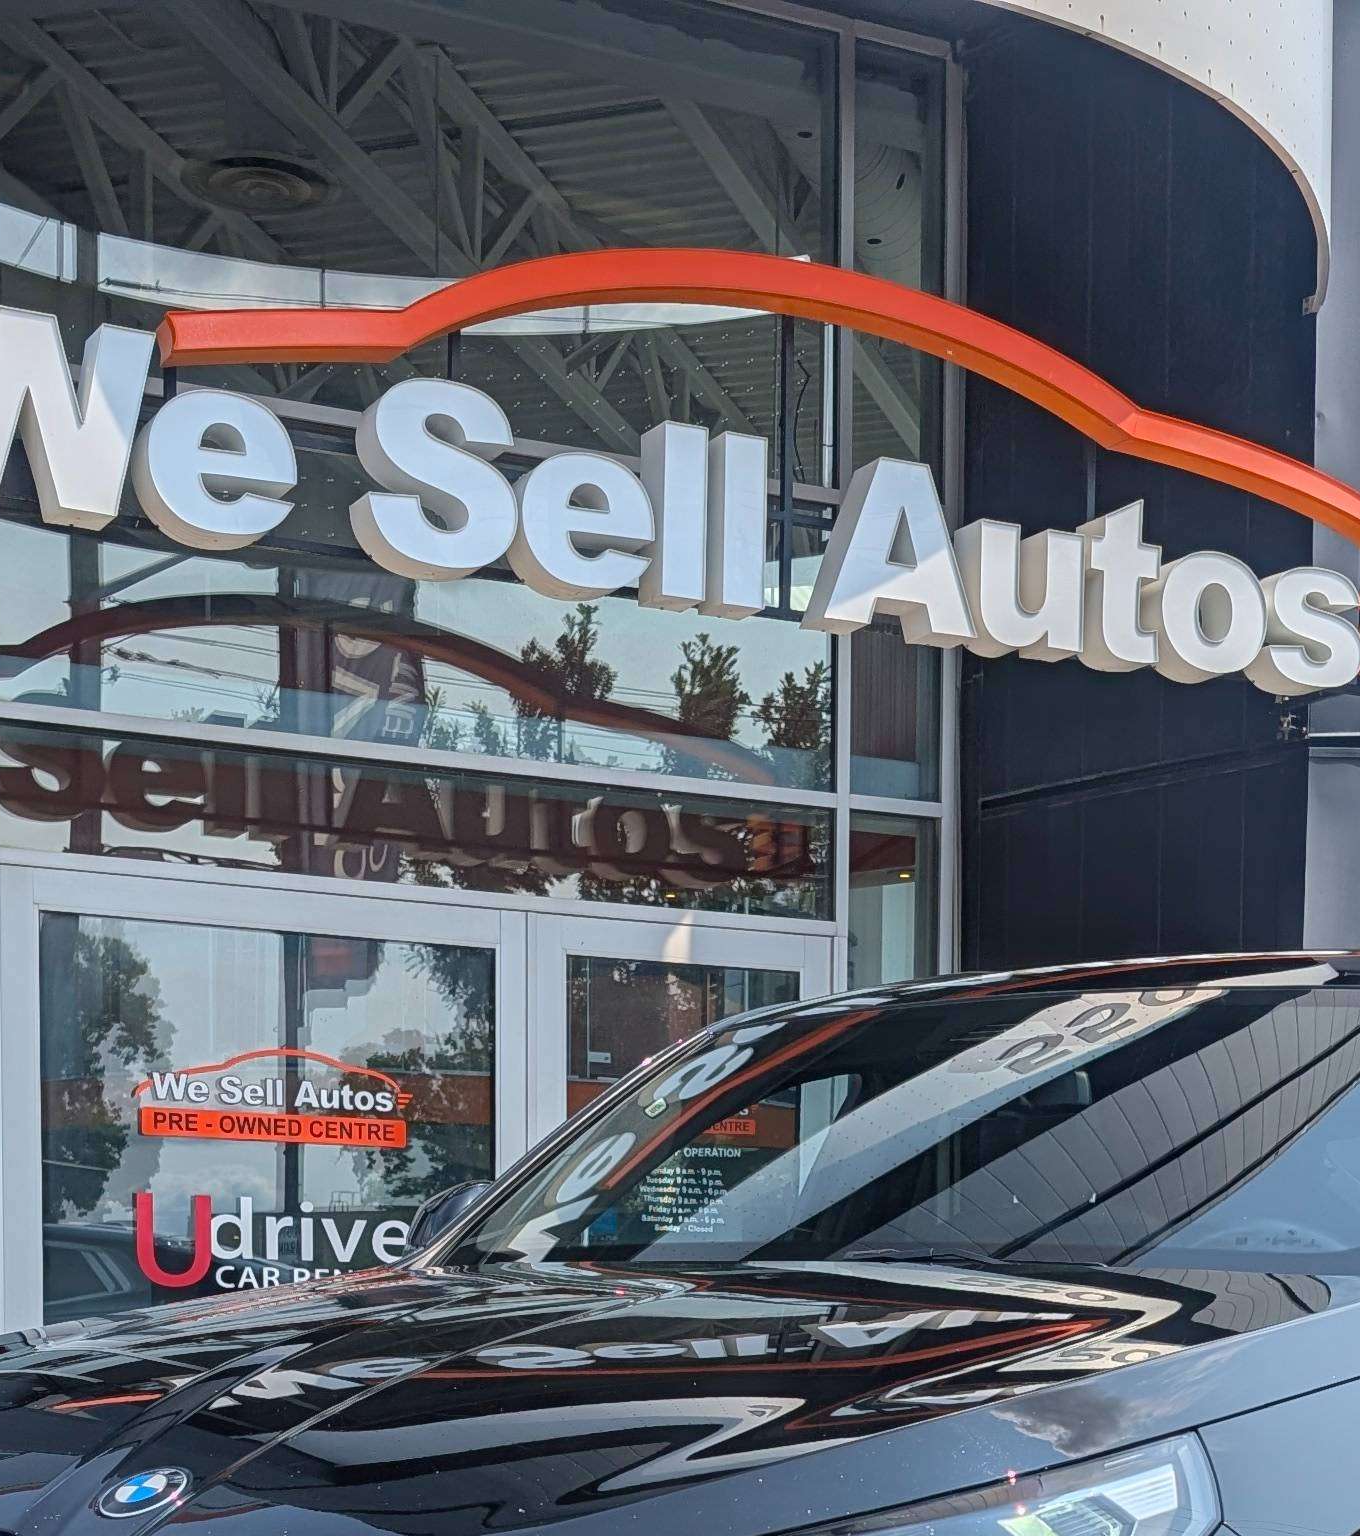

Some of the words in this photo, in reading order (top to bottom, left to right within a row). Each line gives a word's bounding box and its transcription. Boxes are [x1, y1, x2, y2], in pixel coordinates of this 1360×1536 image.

[350, 377, 768, 618] Sell
[148, 1071, 210, 1104] We
[217, 1075, 284, 1108] Sell
[294, 1080, 395, 1112] Autos
[153, 1112, 199, 1132] PRE
[219, 1115, 302, 1137] OWNED
[309, 1120, 396, 1142] CENTRE
[683, 1147, 742, 1158] OPERATION
[135, 1191, 411, 1288] Udrive
[215, 1265, 281, 1290] CAR
